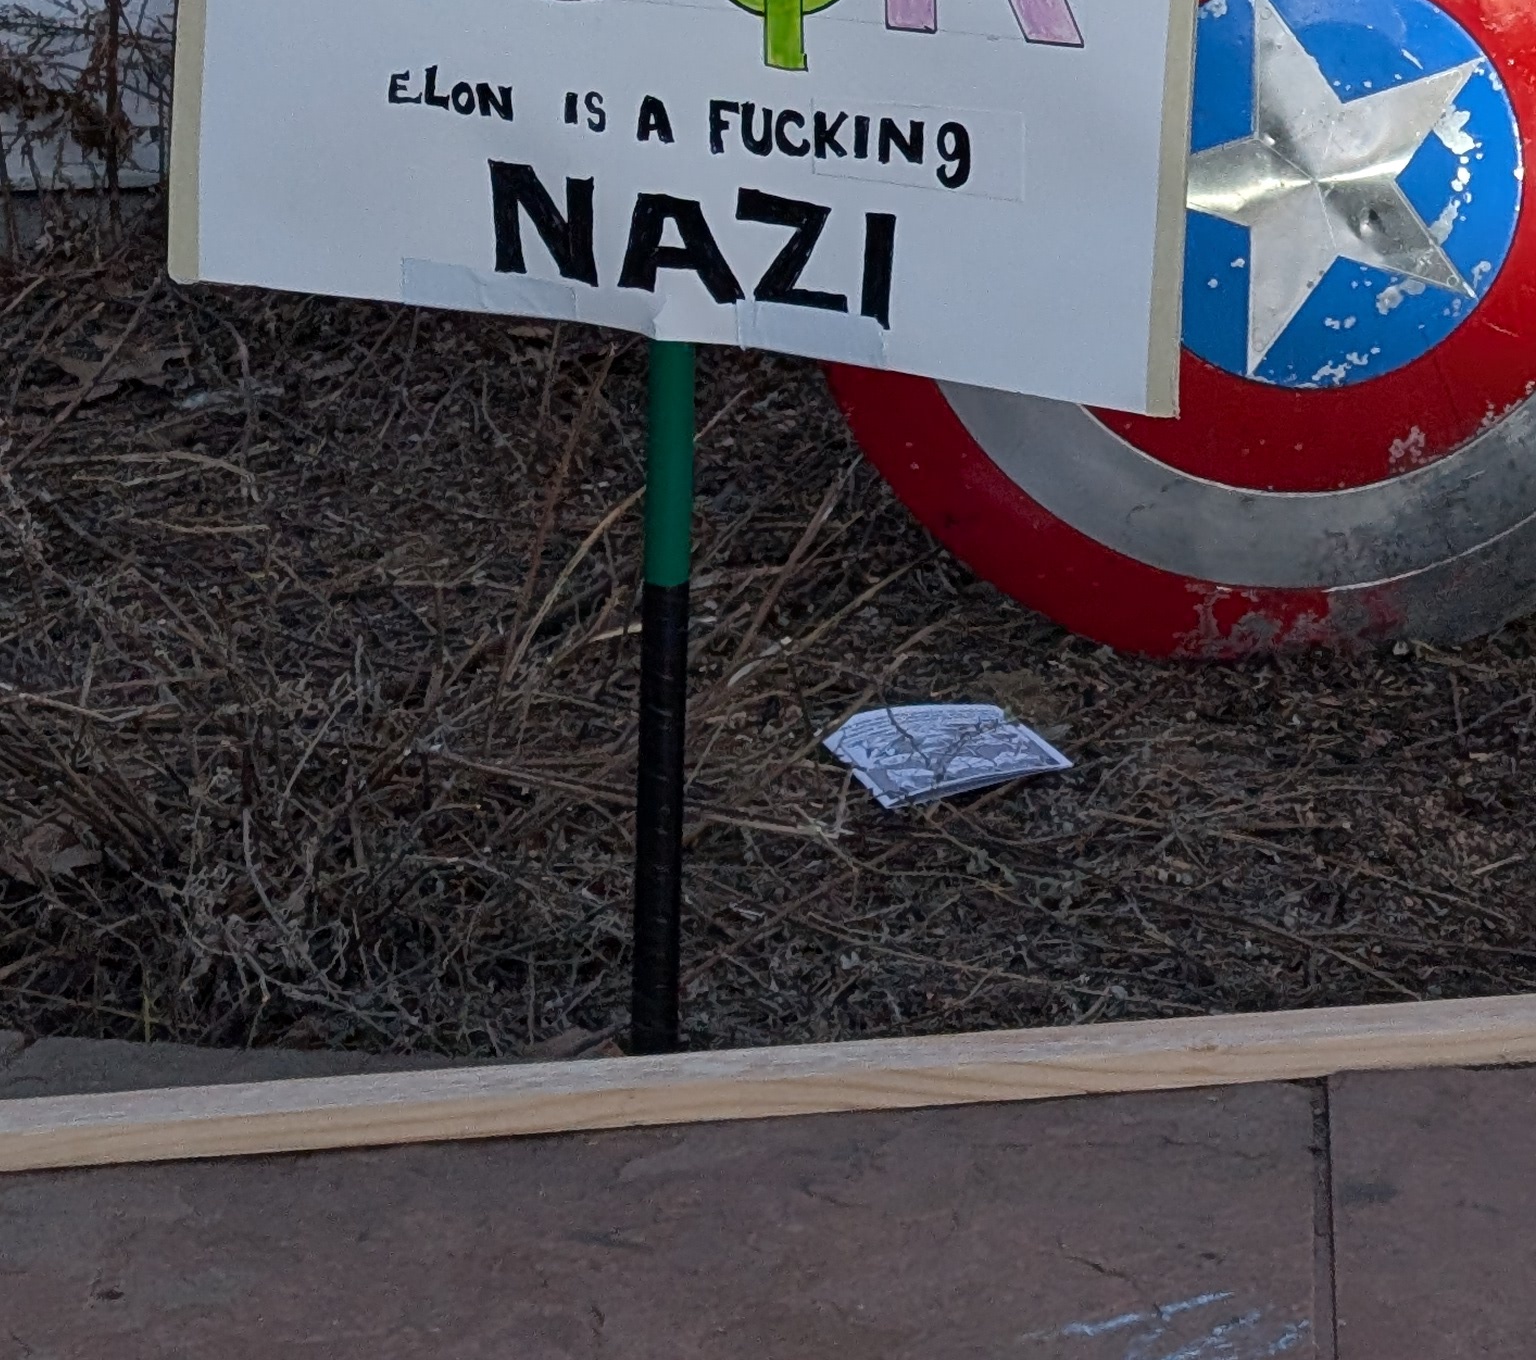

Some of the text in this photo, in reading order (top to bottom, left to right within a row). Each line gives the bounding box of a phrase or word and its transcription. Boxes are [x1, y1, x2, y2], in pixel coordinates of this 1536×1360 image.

[387, 64, 514, 122] ELON
[564, 91, 607, 133] IS
[635, 95, 674, 144] A
[487, 157, 897, 330] NAZI
